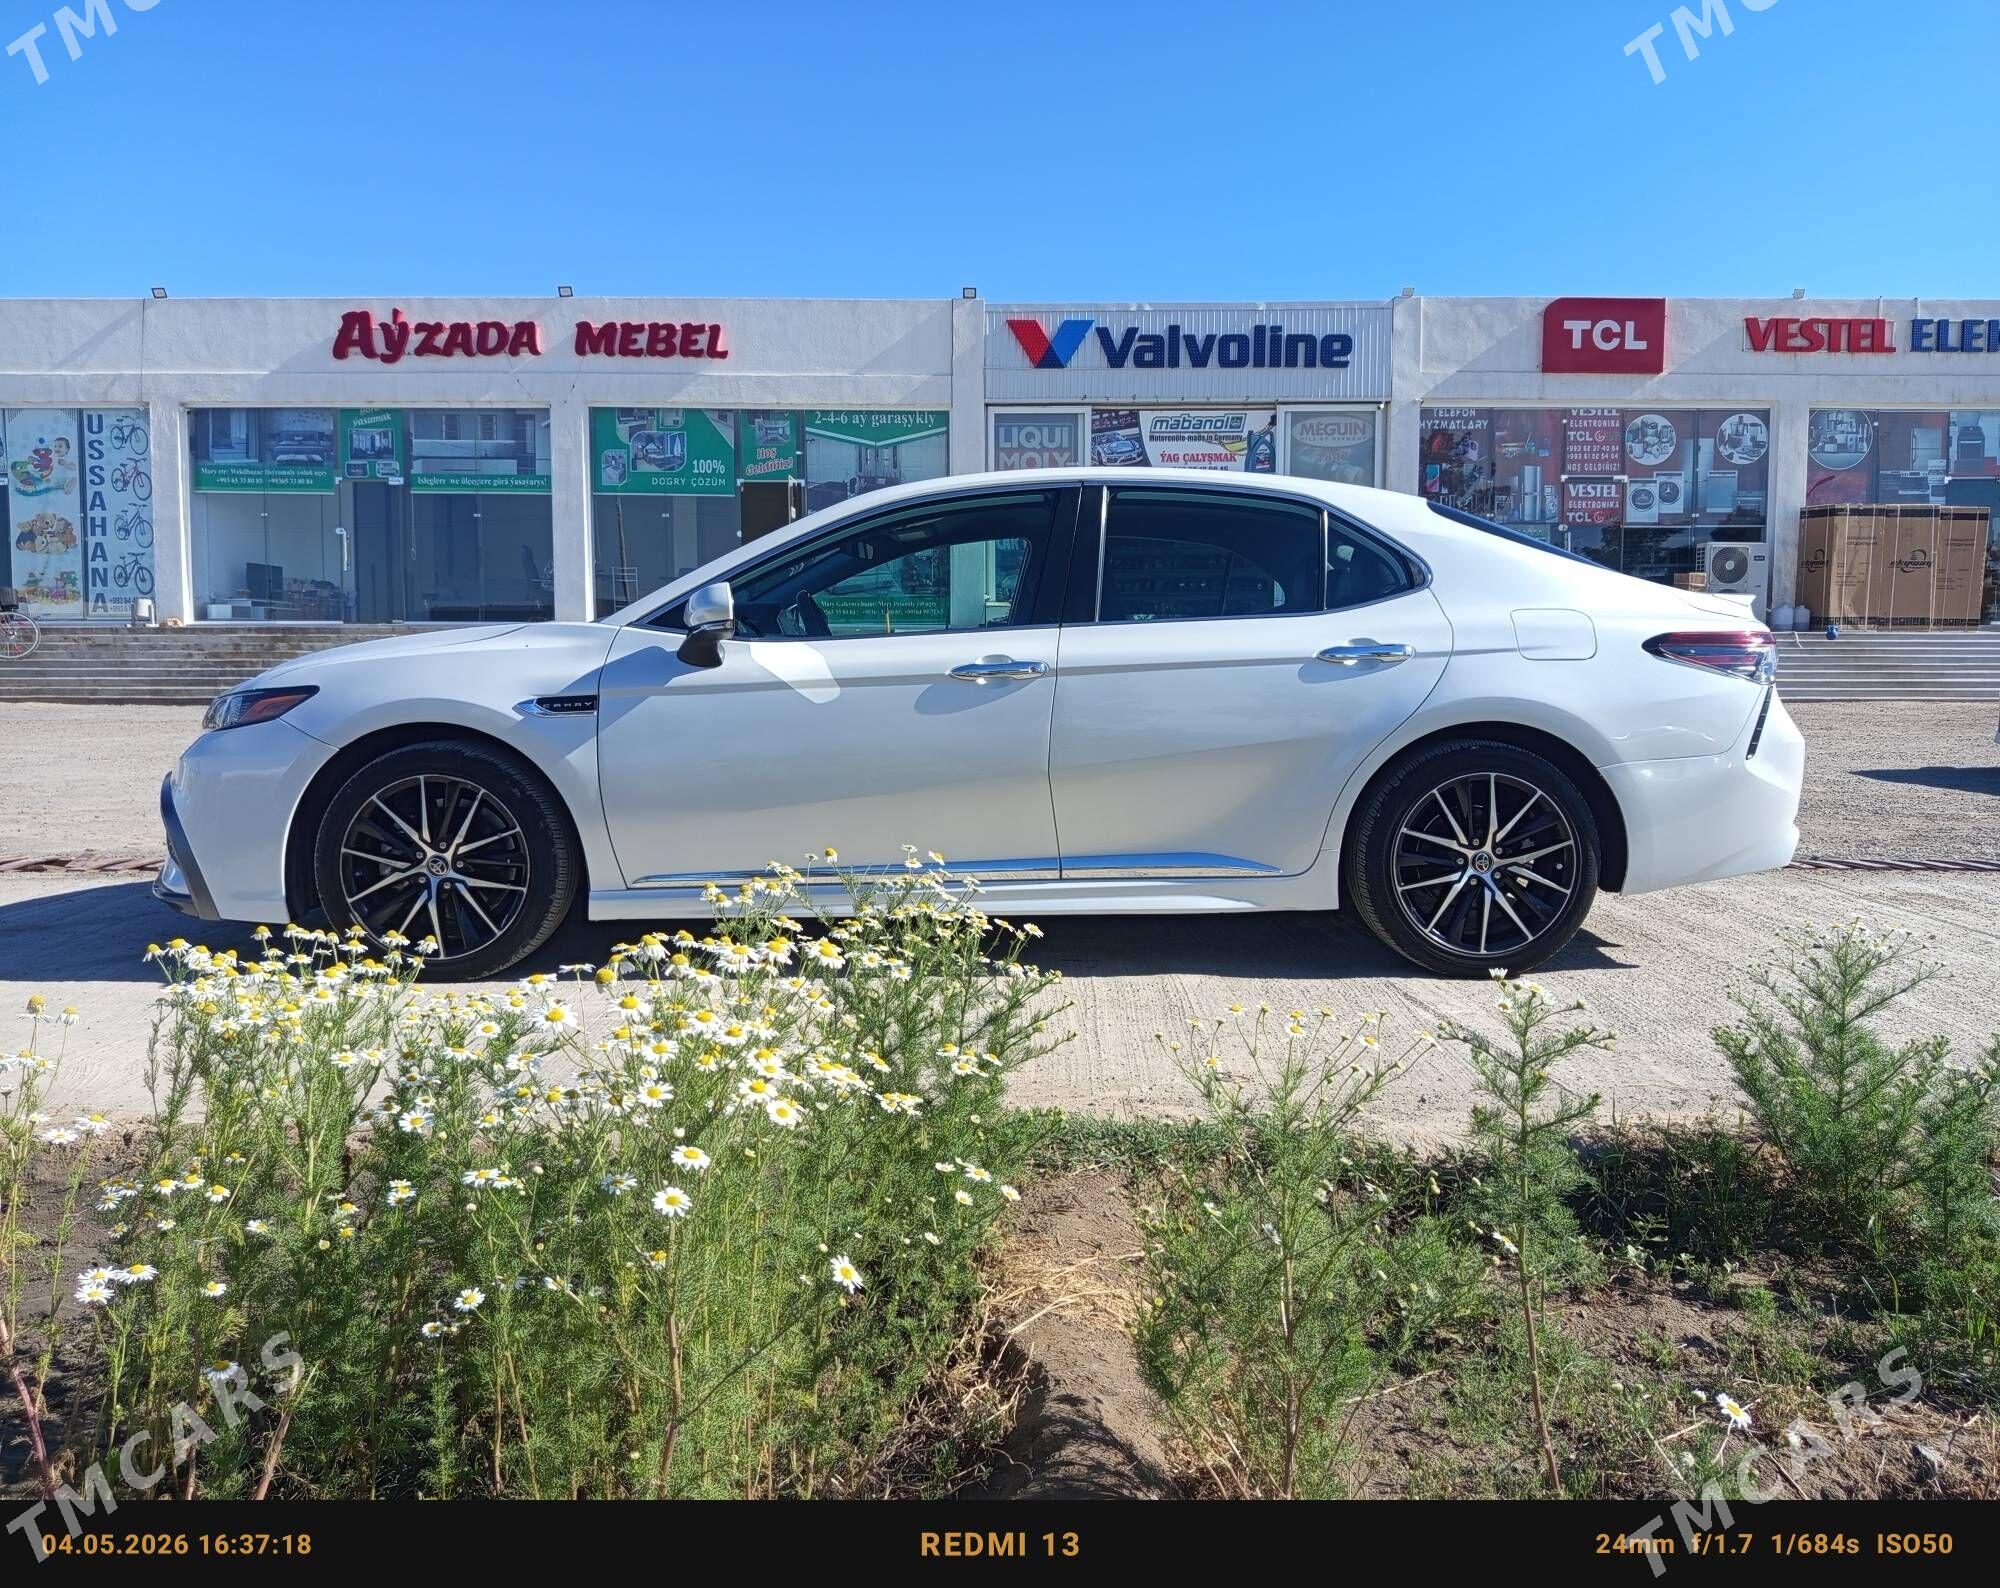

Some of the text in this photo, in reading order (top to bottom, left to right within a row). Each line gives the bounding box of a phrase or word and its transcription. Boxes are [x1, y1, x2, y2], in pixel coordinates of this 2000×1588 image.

[575, 321, 729, 359] MEBEL
[1563, 320, 1648, 351] TCL
[1744, 317, 1896, 352] VESTEL
[1096, 325, 1353, 368] Valvoline
[815, 411, 848, 424] 2-4-6
[852, 413, 868, 427] aý
[1433, 408, 1476, 417] TELEFON
[1419, 420, 1489, 430] HYZMATLARY
[999, 426, 1069, 449] LIQUI
[1568, 431, 1593, 442] TCL
[692, 459, 726, 475] 100%
[1568, 484, 1620, 498] VESTEL
[87, 414, 109, 613] USSAHANA
[1566, 512, 1592, 522] TCL
